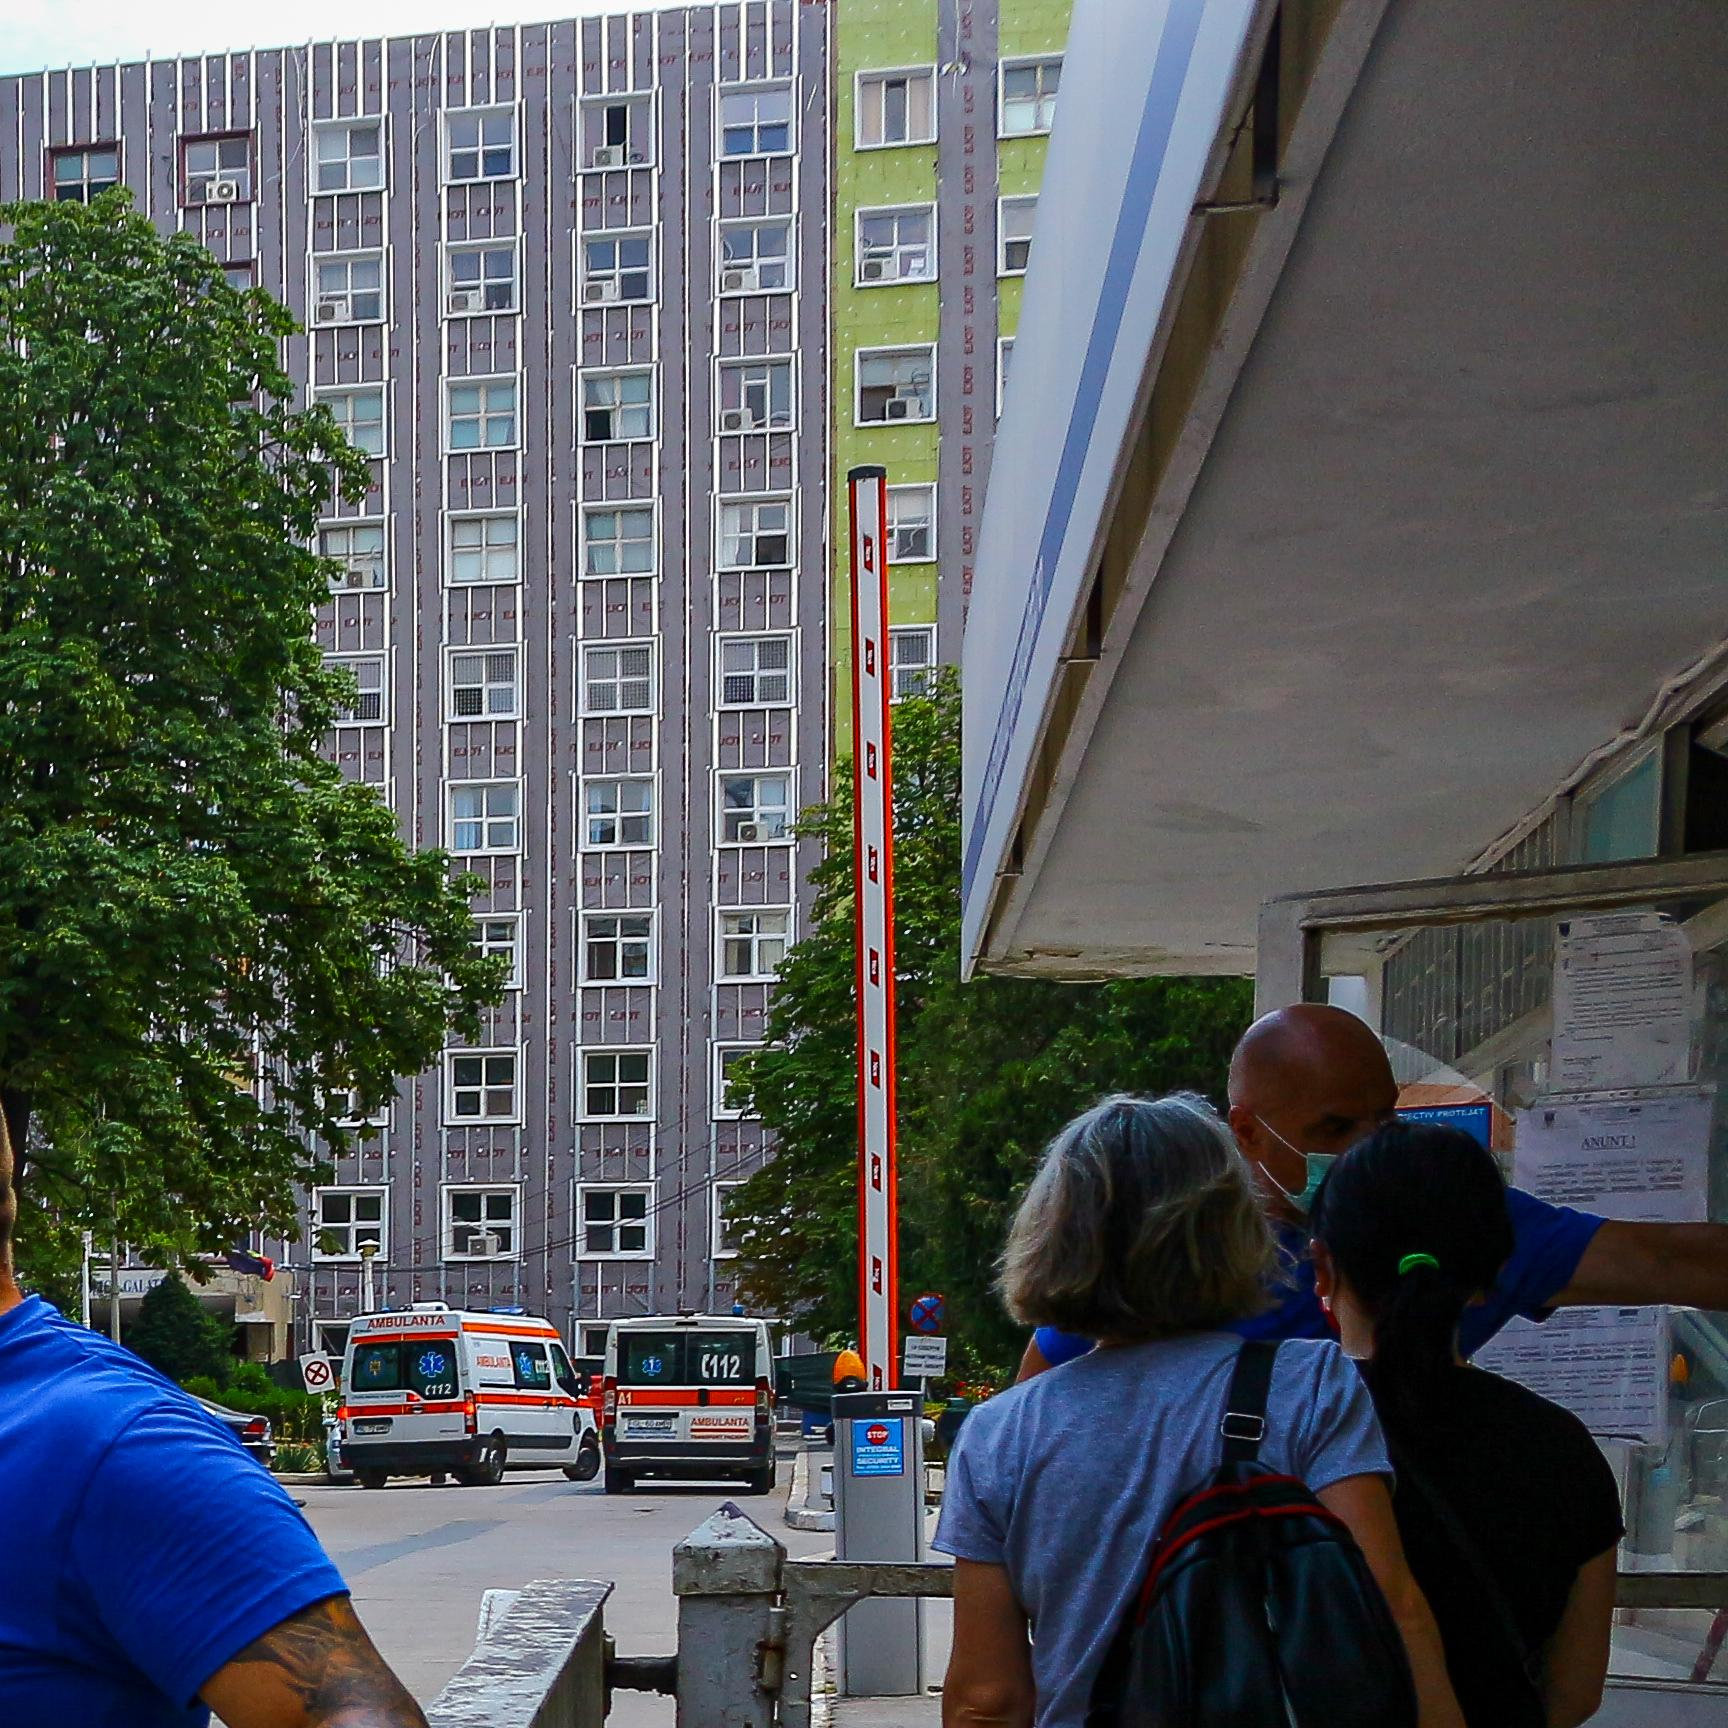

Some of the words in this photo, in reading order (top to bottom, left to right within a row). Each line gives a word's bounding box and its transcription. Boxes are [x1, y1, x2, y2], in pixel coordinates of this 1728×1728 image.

[367, 1315, 446, 1330] AMBULANTA
[710, 1354, 741, 1378] 112
[431, 1384, 452, 1395] 112
[617, 1392, 632, 1405] A1
[690, 1418, 749, 1426] AMBULANTA
[867, 1431, 889, 1440] STOP
